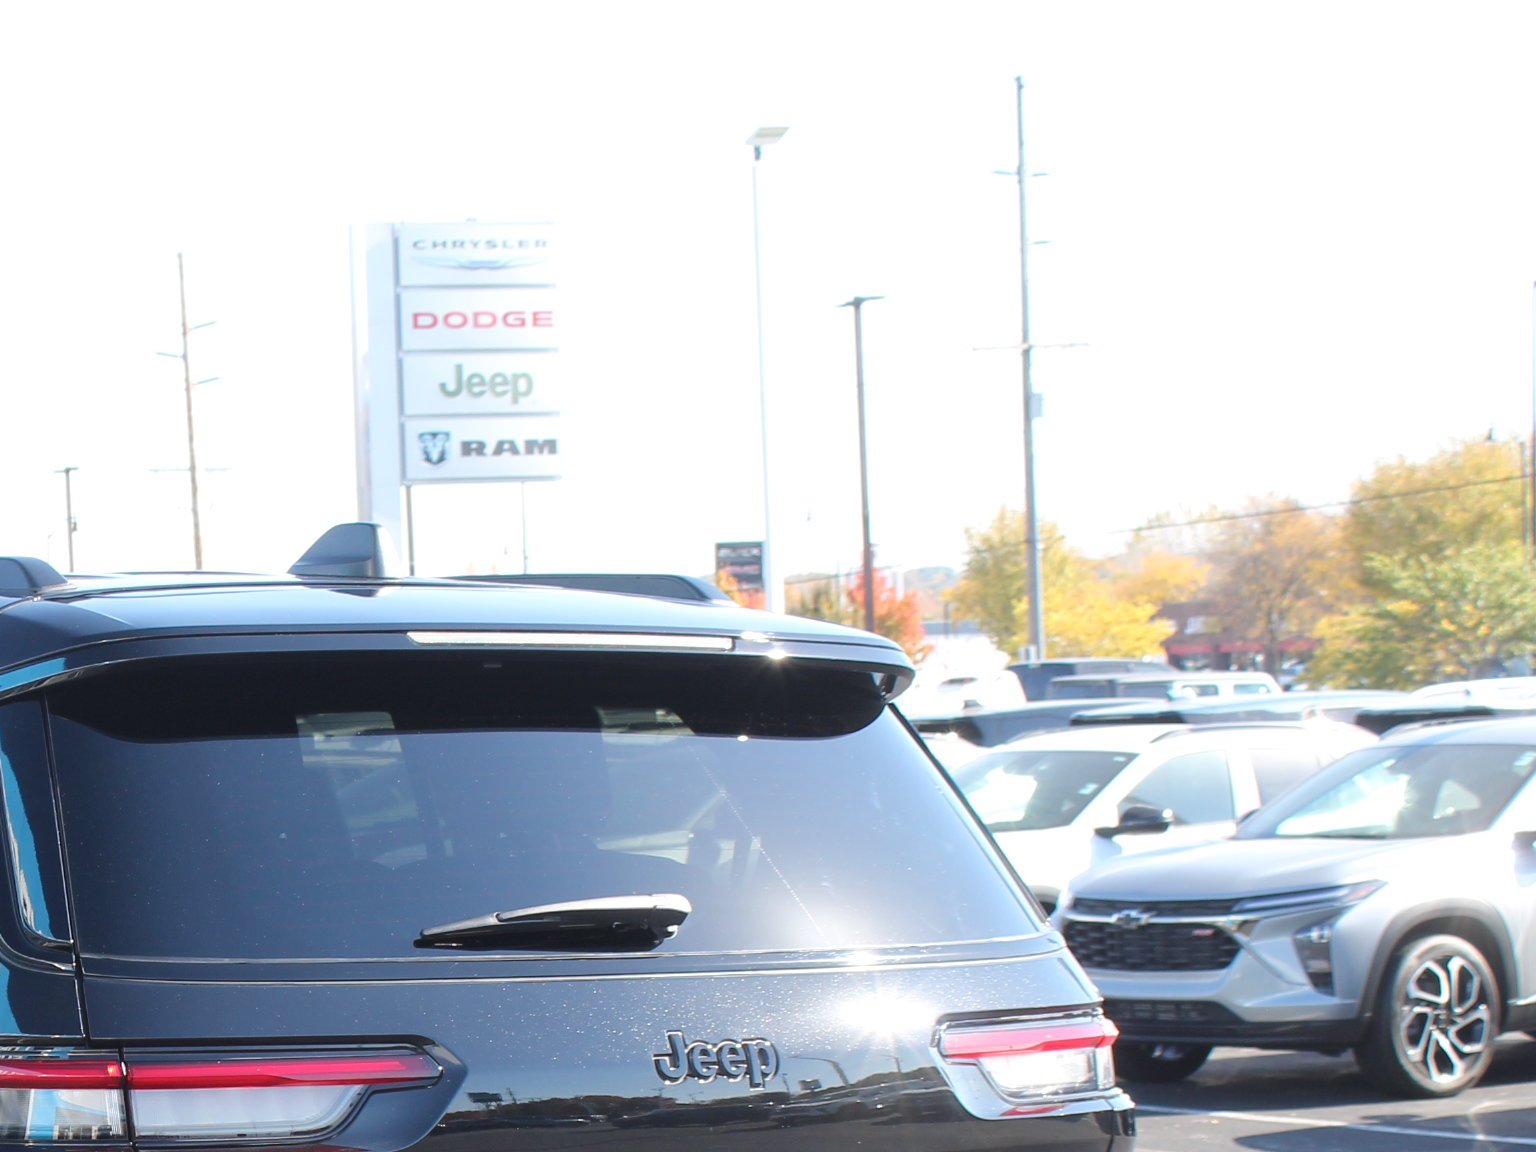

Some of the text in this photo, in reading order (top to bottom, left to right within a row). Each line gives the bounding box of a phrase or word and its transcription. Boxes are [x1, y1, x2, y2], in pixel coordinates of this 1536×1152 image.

[412, 239, 549, 251] CHRYSLER
[412, 311, 554, 329] DODGE
[438, 363, 534, 405] Jeep
[459, 438, 558, 457] RAM
[652, 1029, 780, 1091] Jeep
